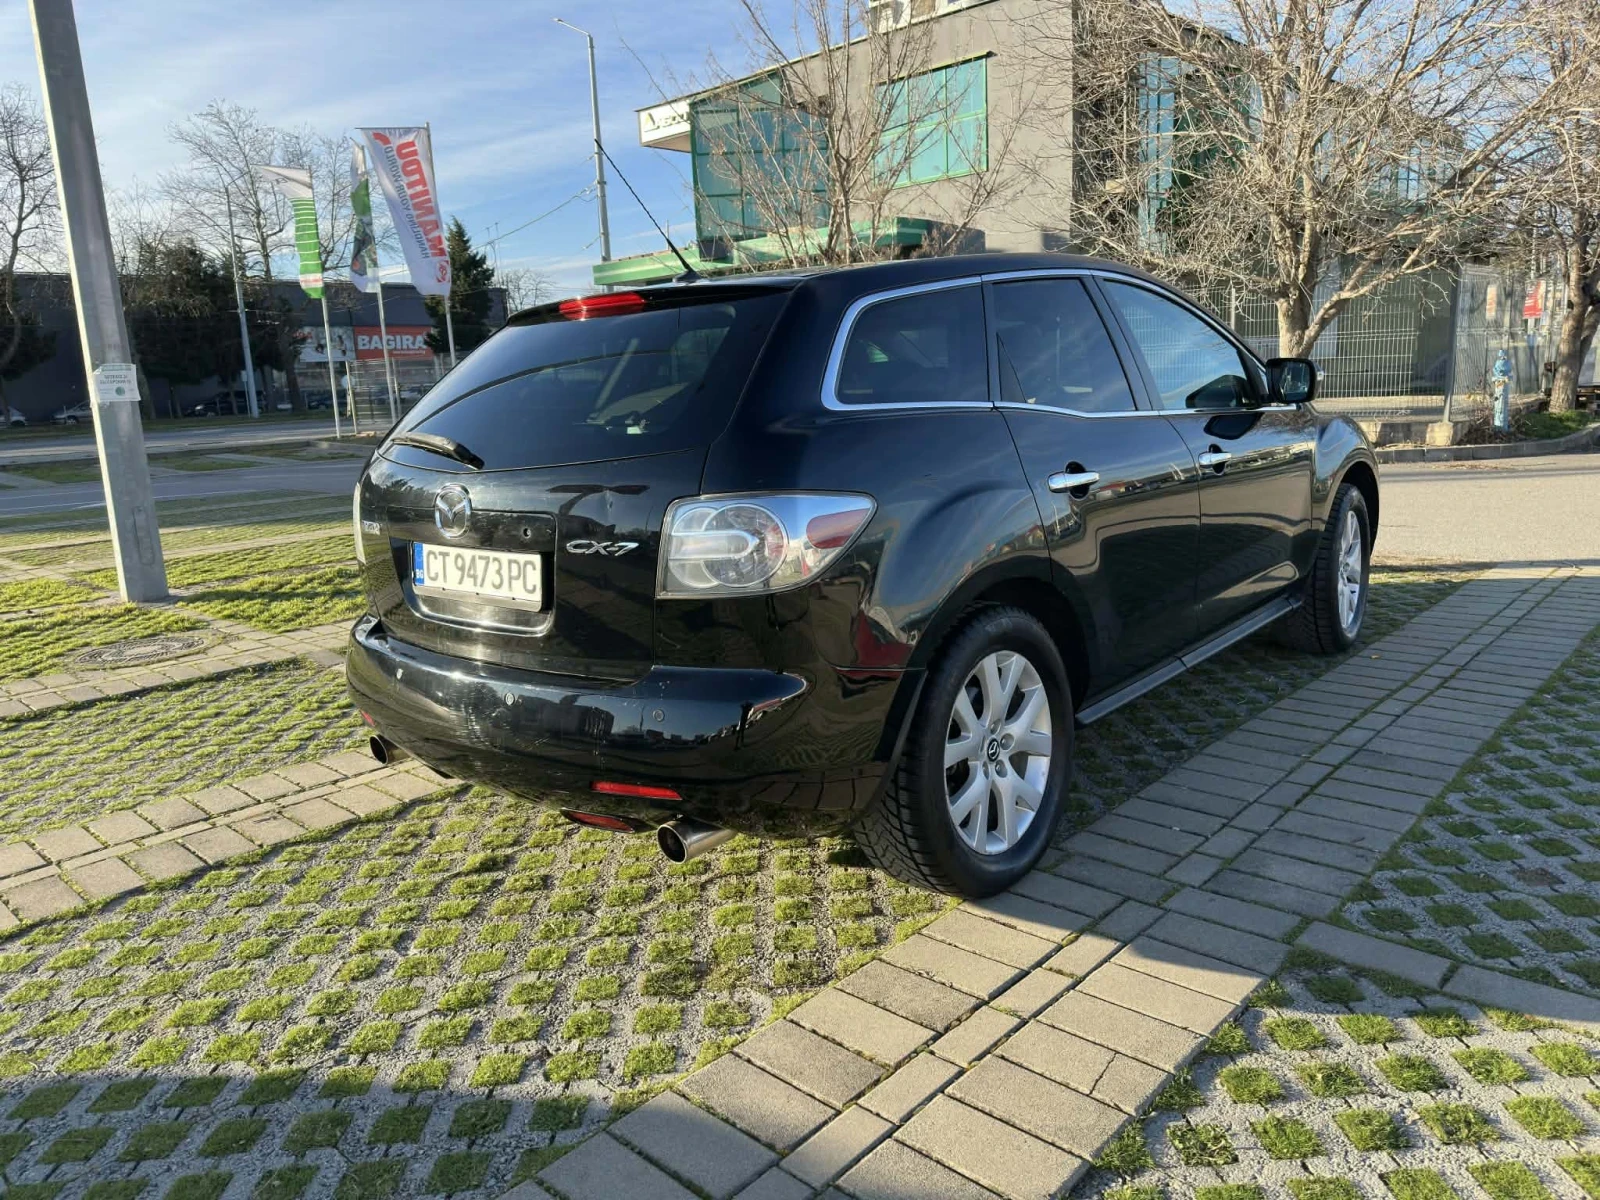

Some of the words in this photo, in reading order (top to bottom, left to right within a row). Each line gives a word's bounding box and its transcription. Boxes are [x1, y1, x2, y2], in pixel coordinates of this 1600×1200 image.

[357, 335, 427, 349] BAGIRA
[566, 540, 639, 556] CX-7
[414, 568, 424, 580] BG
[425, 550, 451, 583] CT
[453, 556, 504, 589] 9473
[507, 561, 537, 594] PC
